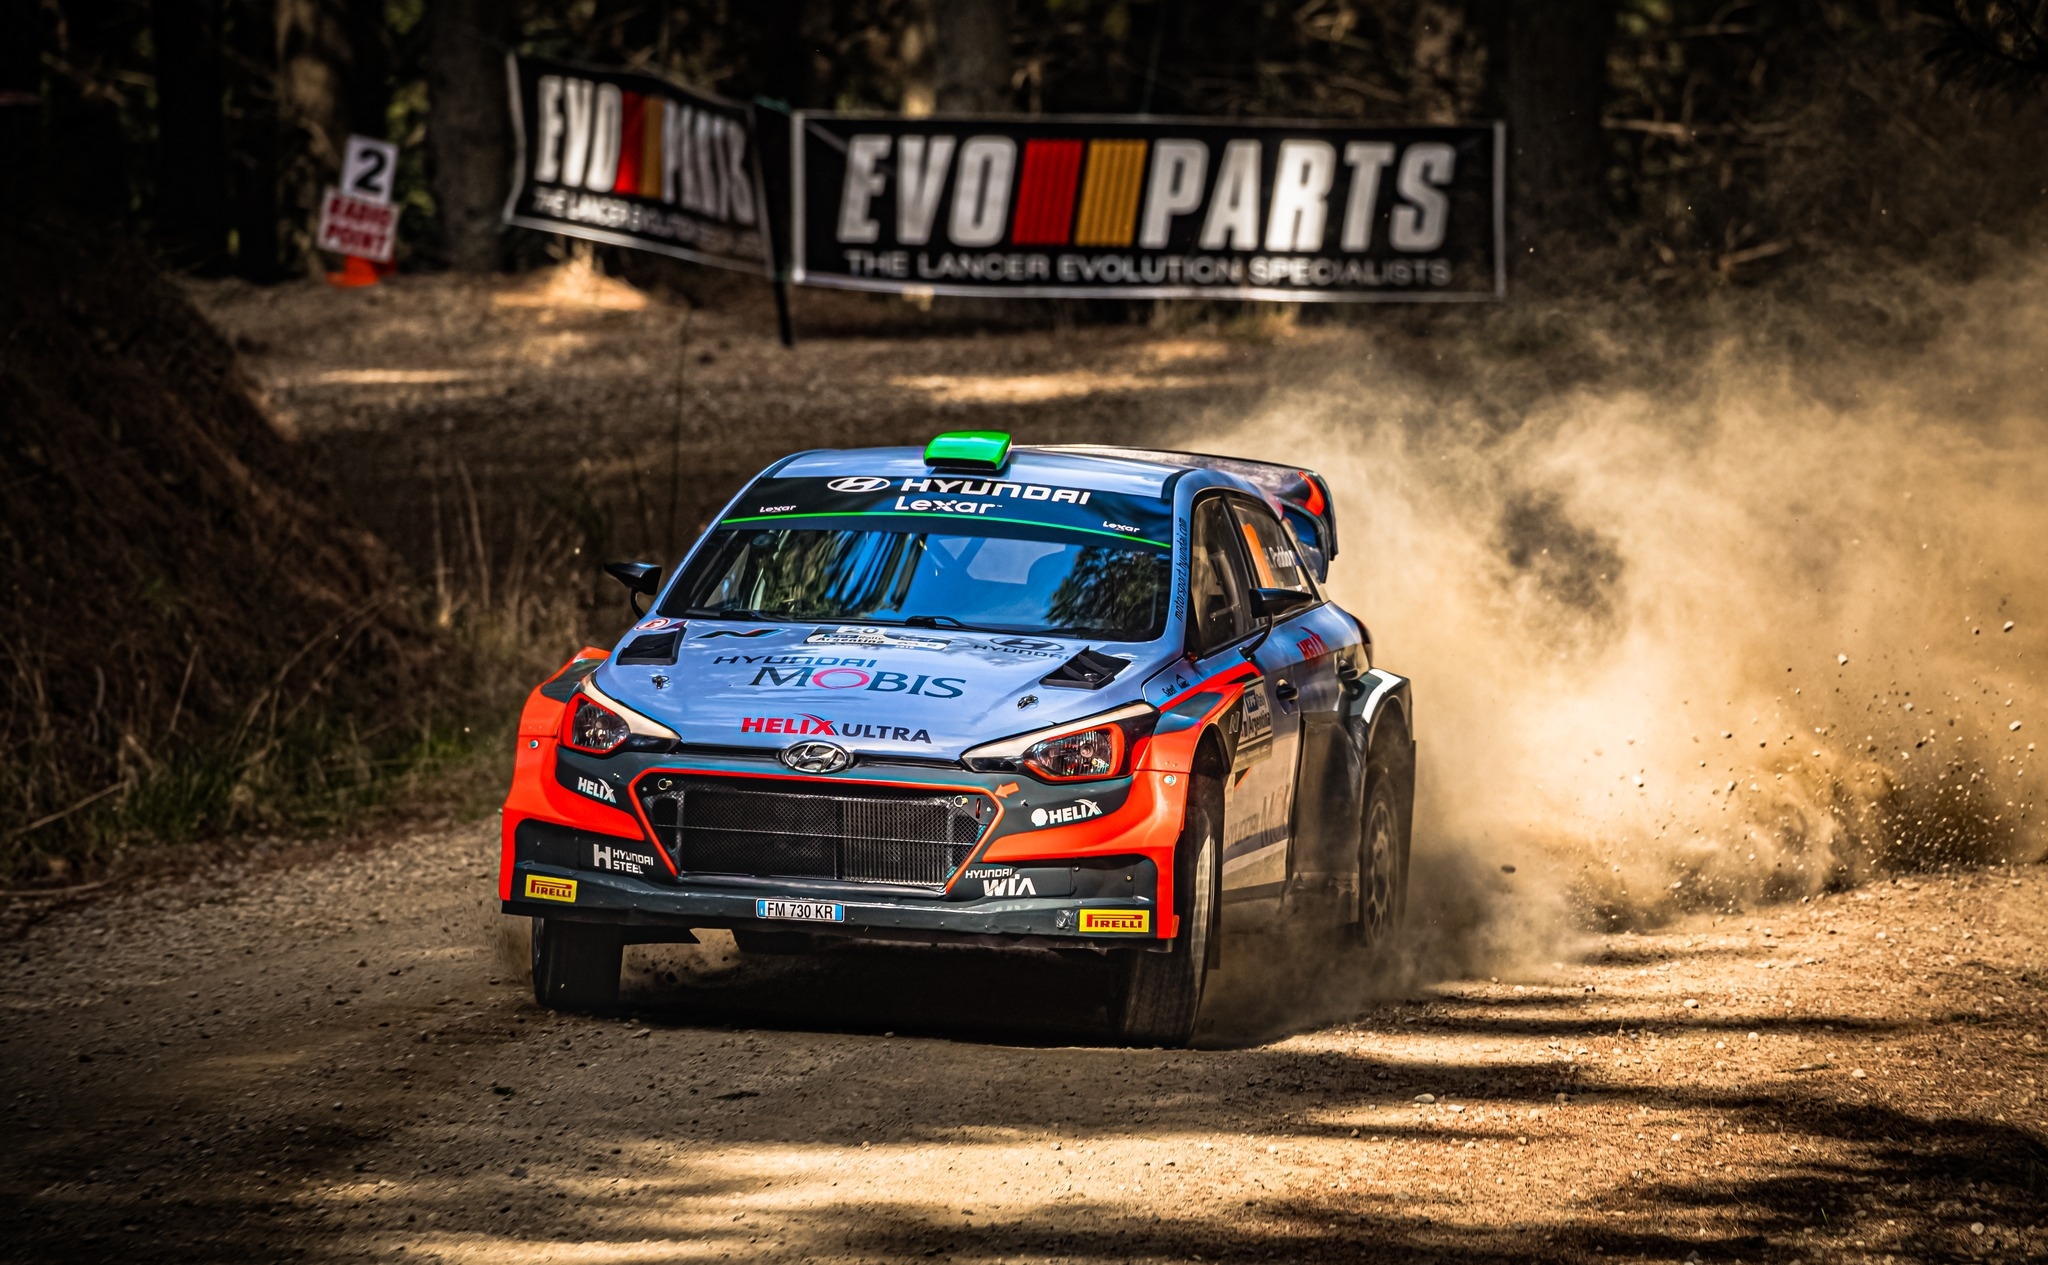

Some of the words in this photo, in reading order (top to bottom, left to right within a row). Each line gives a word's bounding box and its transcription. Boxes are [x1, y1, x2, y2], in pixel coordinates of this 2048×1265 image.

[534, 74, 623, 193] EVO
[354, 148, 387, 193] 2
[837, 134, 1017, 246] EVO
[1138, 138, 1457, 252] PARTS
[844, 249, 910, 279] THE
[917, 251, 1050, 281] LANCER
[1057, 253, 1243, 286] EVOLUTION
[1249, 255, 1451, 287] SPECIALISTS
[900, 478, 1092, 505] HYUNDAI
[759, 504, 797, 514] Lexar
[894, 496, 996, 514] Lexar
[1102, 520, 1140, 533] Lexar
[713, 656, 878, 668] HYUNDAI
[973, 645, 1070, 660] HYUNDAI
[748, 667, 967, 699] MOBIS
[740, 713, 840, 736] HELIX
[842, 723, 932, 744] ULTRA
[577, 777, 617, 804] HELIX
[1049, 799, 1103, 824] HELIX
[612, 849, 654, 866] HYUNDAI
[613, 860, 644, 874] STEEL
[965, 868, 1013, 879] HYUNDAI
[530, 879, 572, 899] PIRELLI
[767, 902, 786, 917] FM
[789, 904, 812, 919] 730
[815, 905, 833, 919] KR
[1086, 913, 1143, 928] PIRELLI
